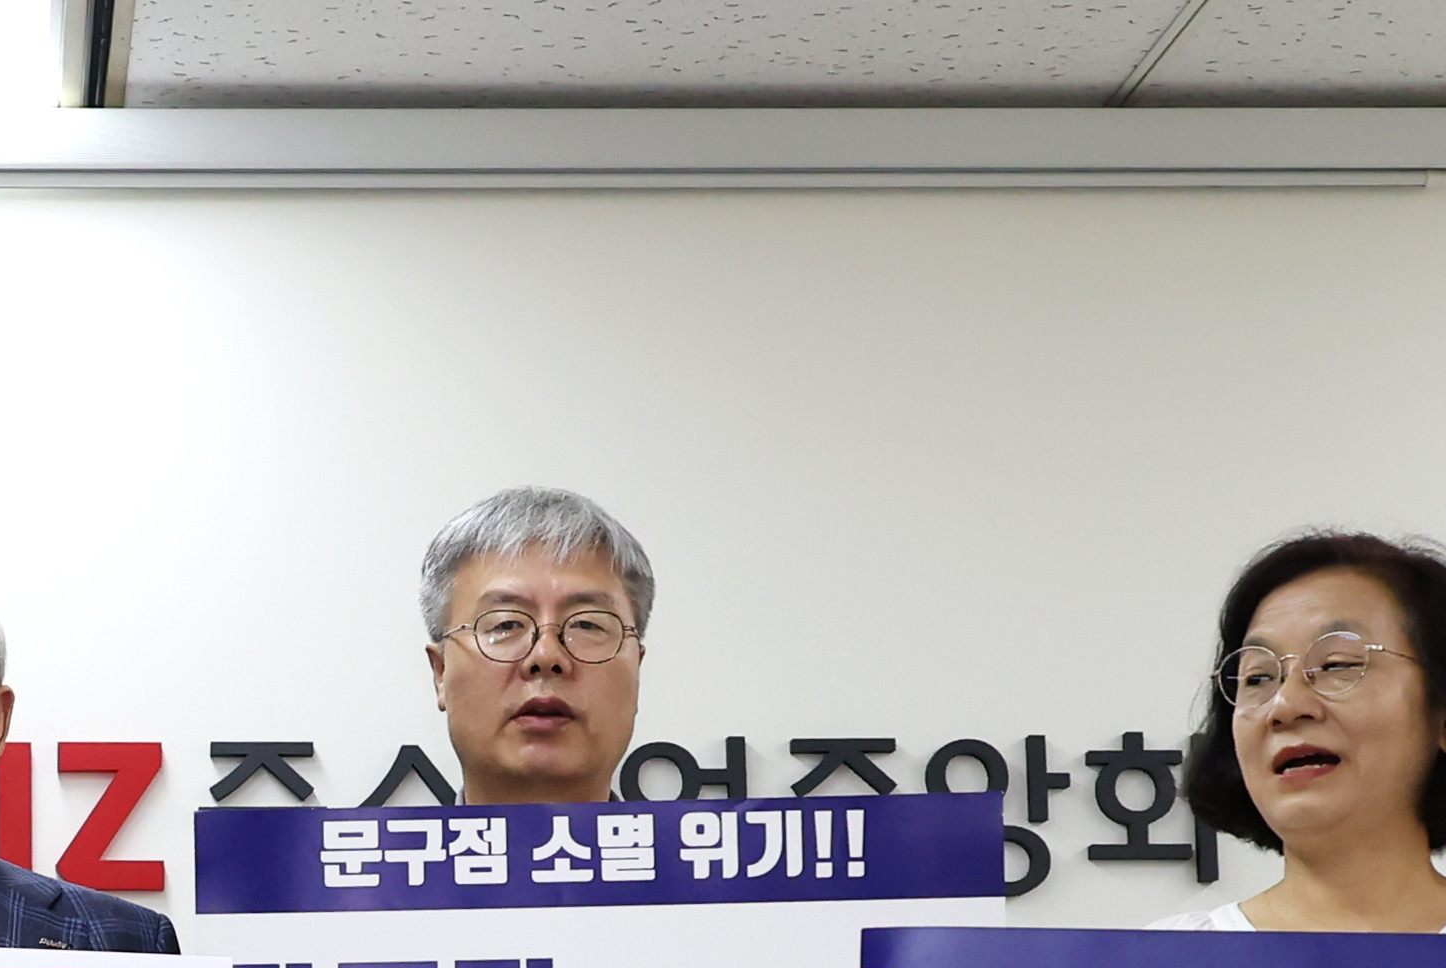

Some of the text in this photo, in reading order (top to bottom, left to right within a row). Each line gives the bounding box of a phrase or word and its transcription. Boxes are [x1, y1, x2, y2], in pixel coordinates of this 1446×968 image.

[320, 809, 865, 888] 문구점 소멸 위기!!
